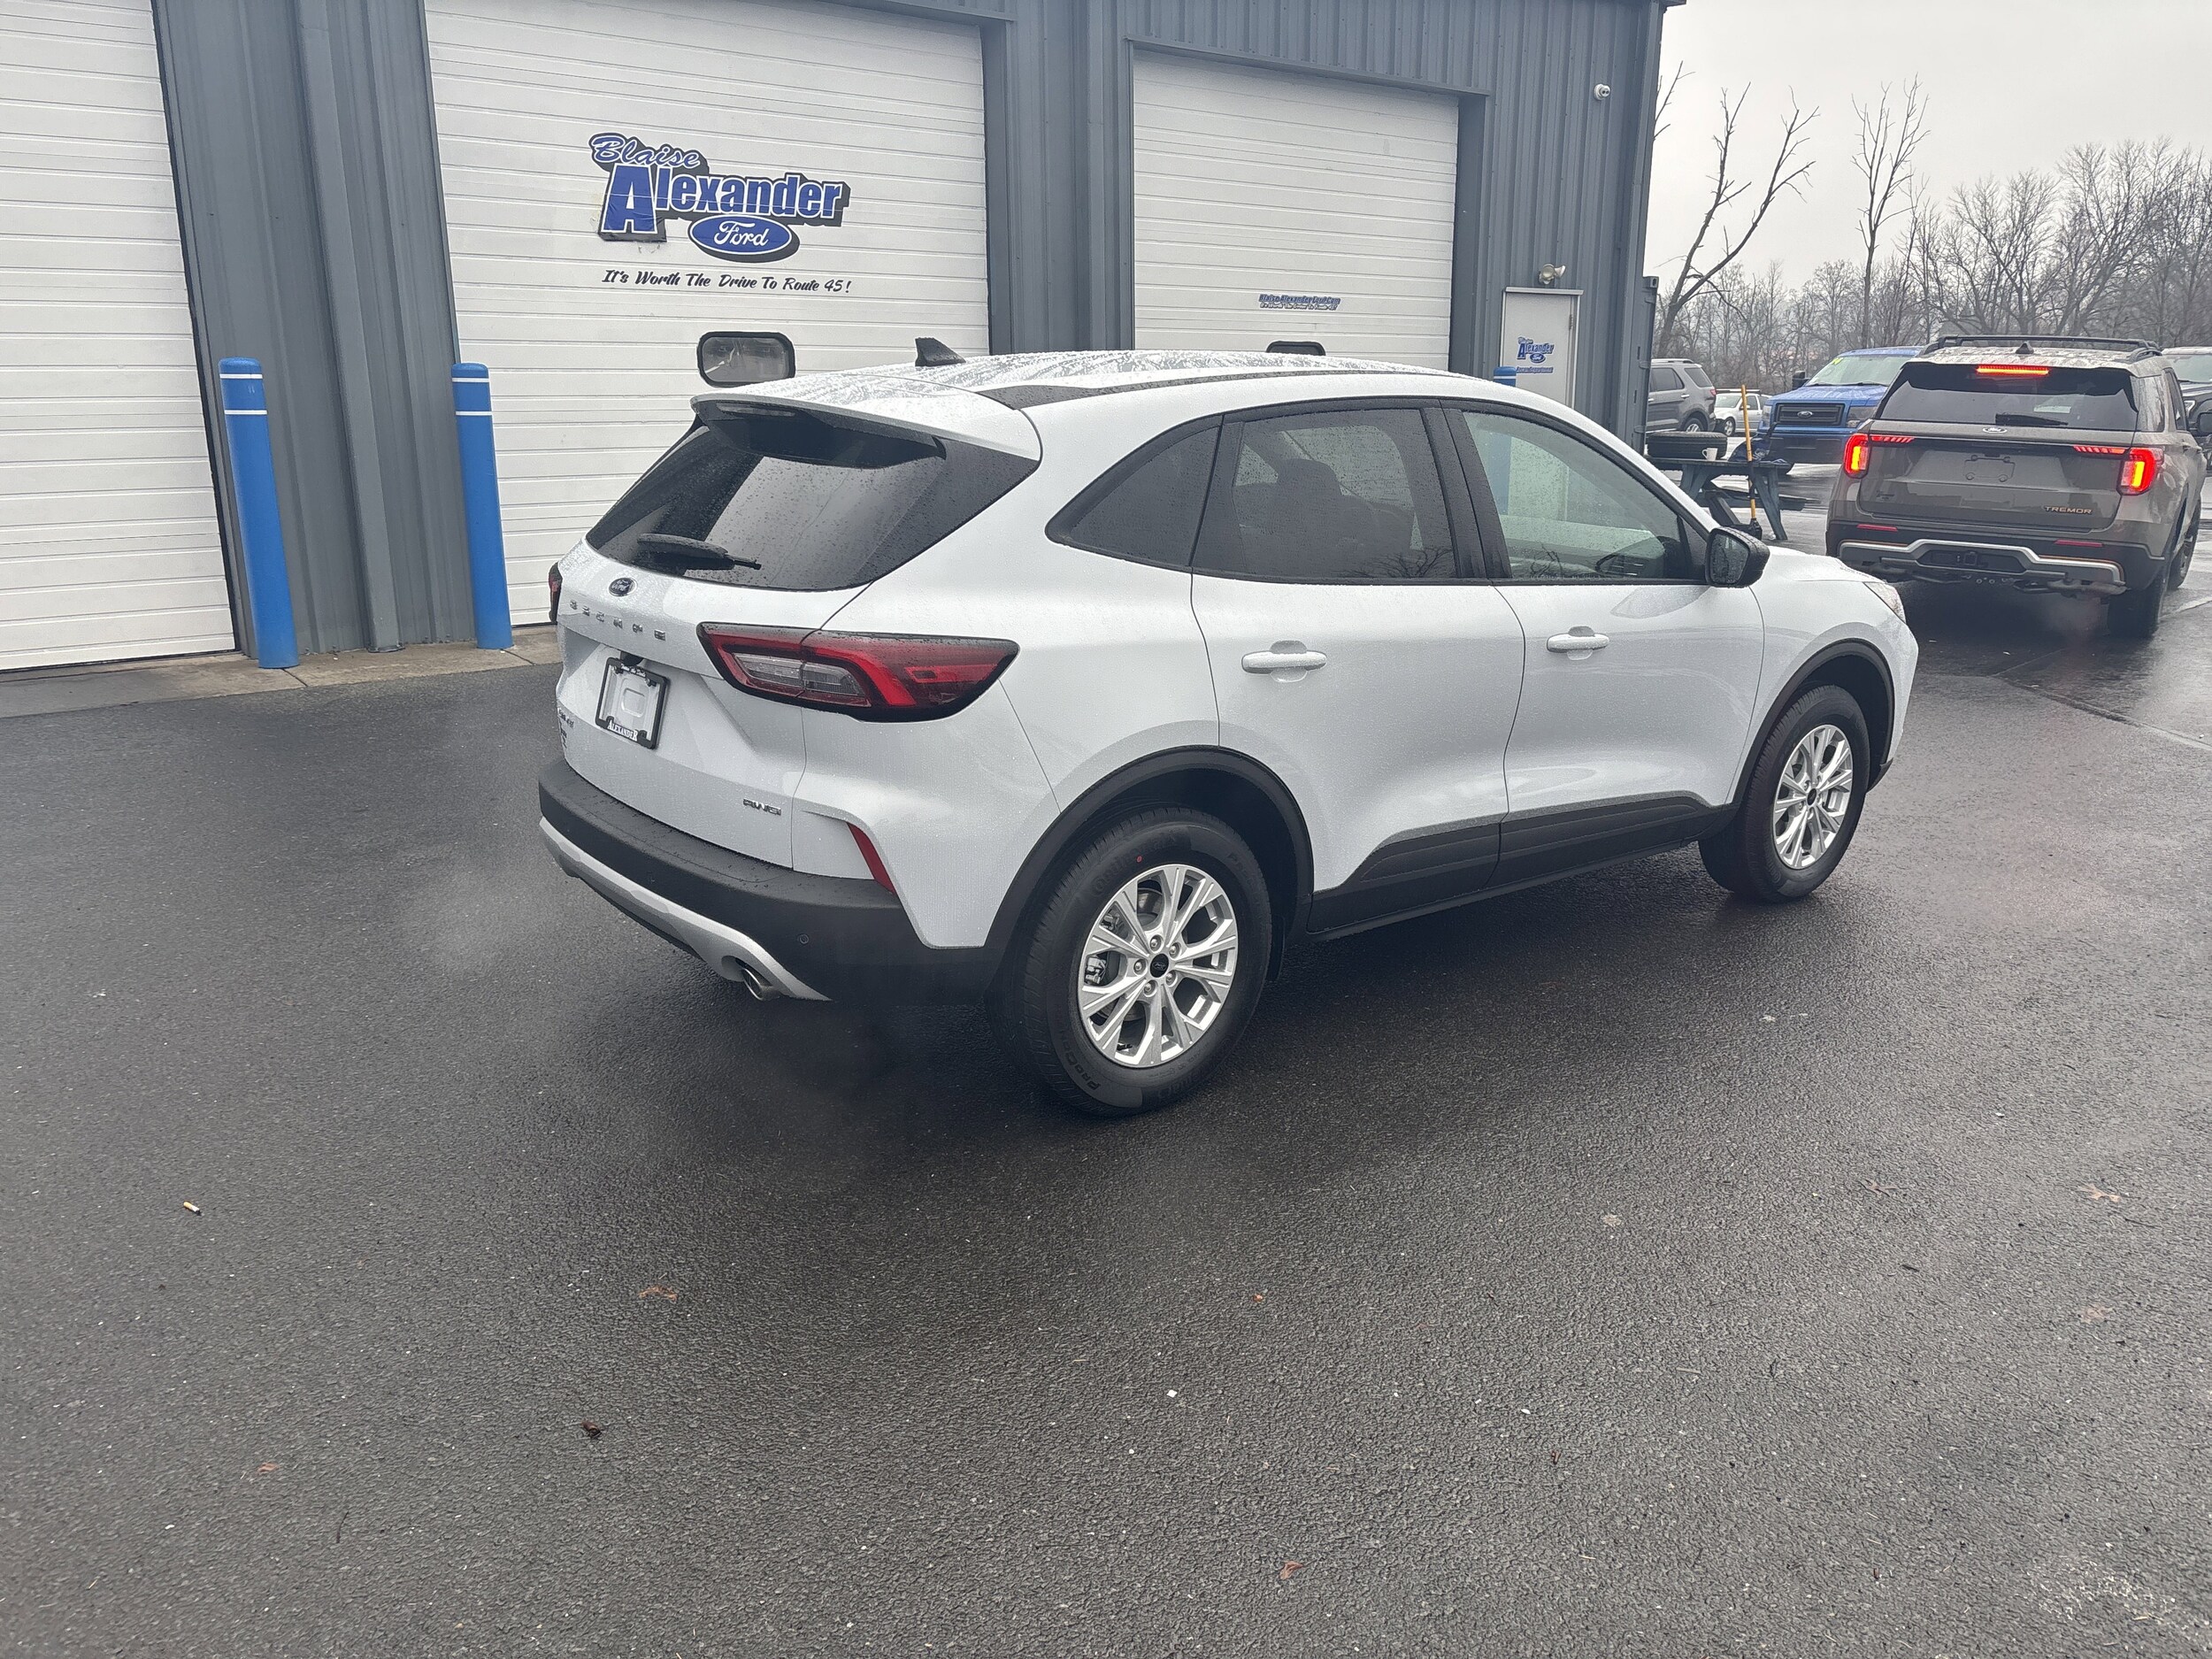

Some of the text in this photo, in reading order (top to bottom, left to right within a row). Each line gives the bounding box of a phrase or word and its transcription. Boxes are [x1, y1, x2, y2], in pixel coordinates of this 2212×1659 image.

[591, 134, 703, 169] Blaise
[600, 163, 845, 235] Alexander
[713, 221, 769, 247] Ford
[602, 269, 630, 283] It's
[634, 271, 681, 286] Worth
[686, 273, 711, 288] The
[718, 273, 758, 289] Drive
[762, 276, 778, 290] To
[782, 278, 820, 292] Route
[2045, 505, 2093, 515] TREMOR
